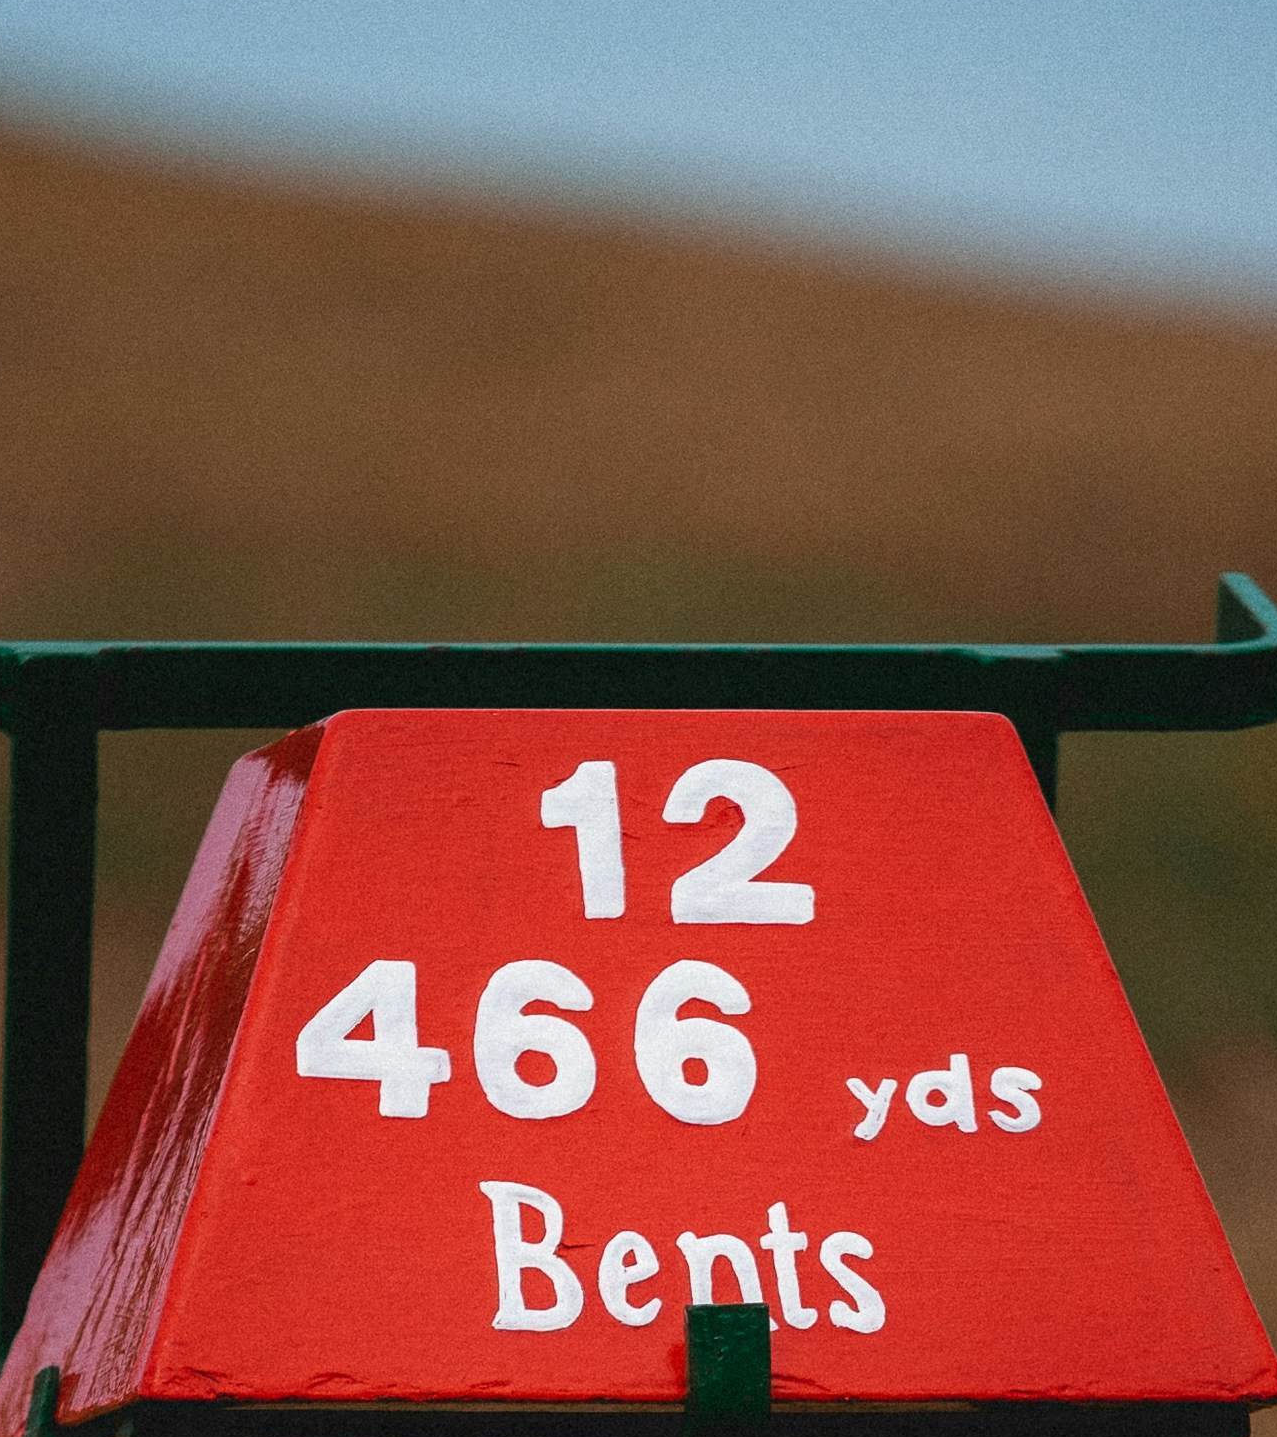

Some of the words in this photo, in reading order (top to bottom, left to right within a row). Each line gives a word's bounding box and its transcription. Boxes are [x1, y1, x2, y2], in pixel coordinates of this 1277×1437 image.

[540, 758, 816, 925] 12
[295, 959, 758, 1126] 466
[845, 1053, 1044, 1141] yds
[479, 1180, 886, 1334] Bents
